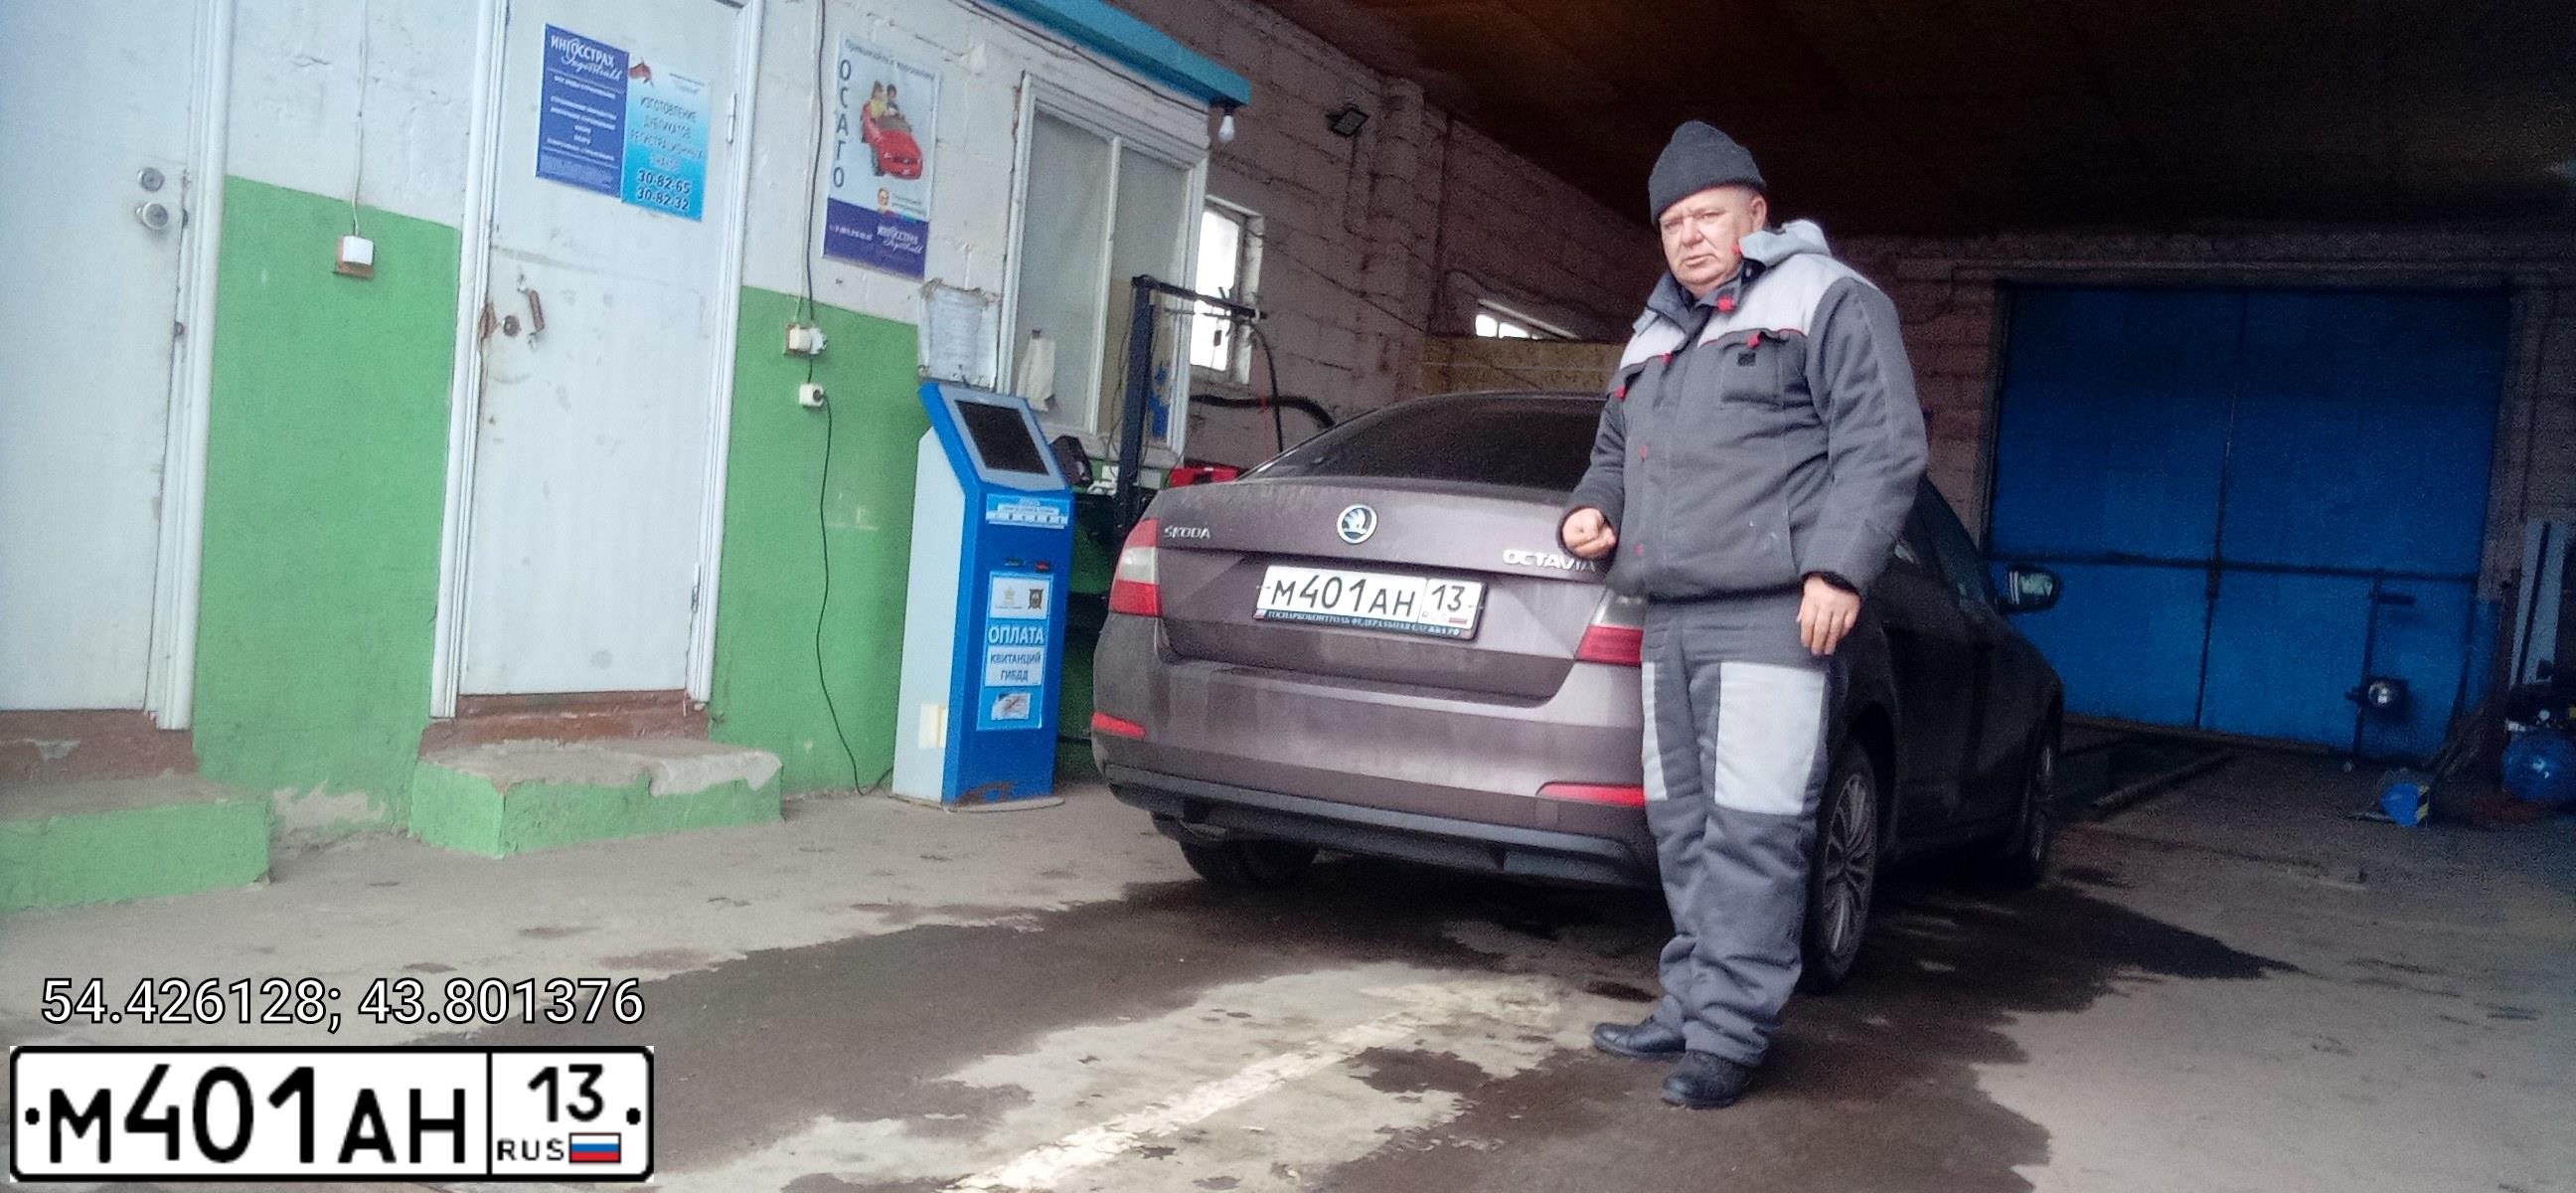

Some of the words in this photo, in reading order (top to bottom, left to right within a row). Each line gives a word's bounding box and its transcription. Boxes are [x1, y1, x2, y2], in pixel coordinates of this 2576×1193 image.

[833, 60, 852, 188] ОСАГО
[1431, 584, 1466, 612] 13
[988, 625, 1045, 645] ОПЛАТА
[990, 651, 1042, 666] КВИТАНЦИЙ
[1000, 669, 1029, 682] ГИБДД
